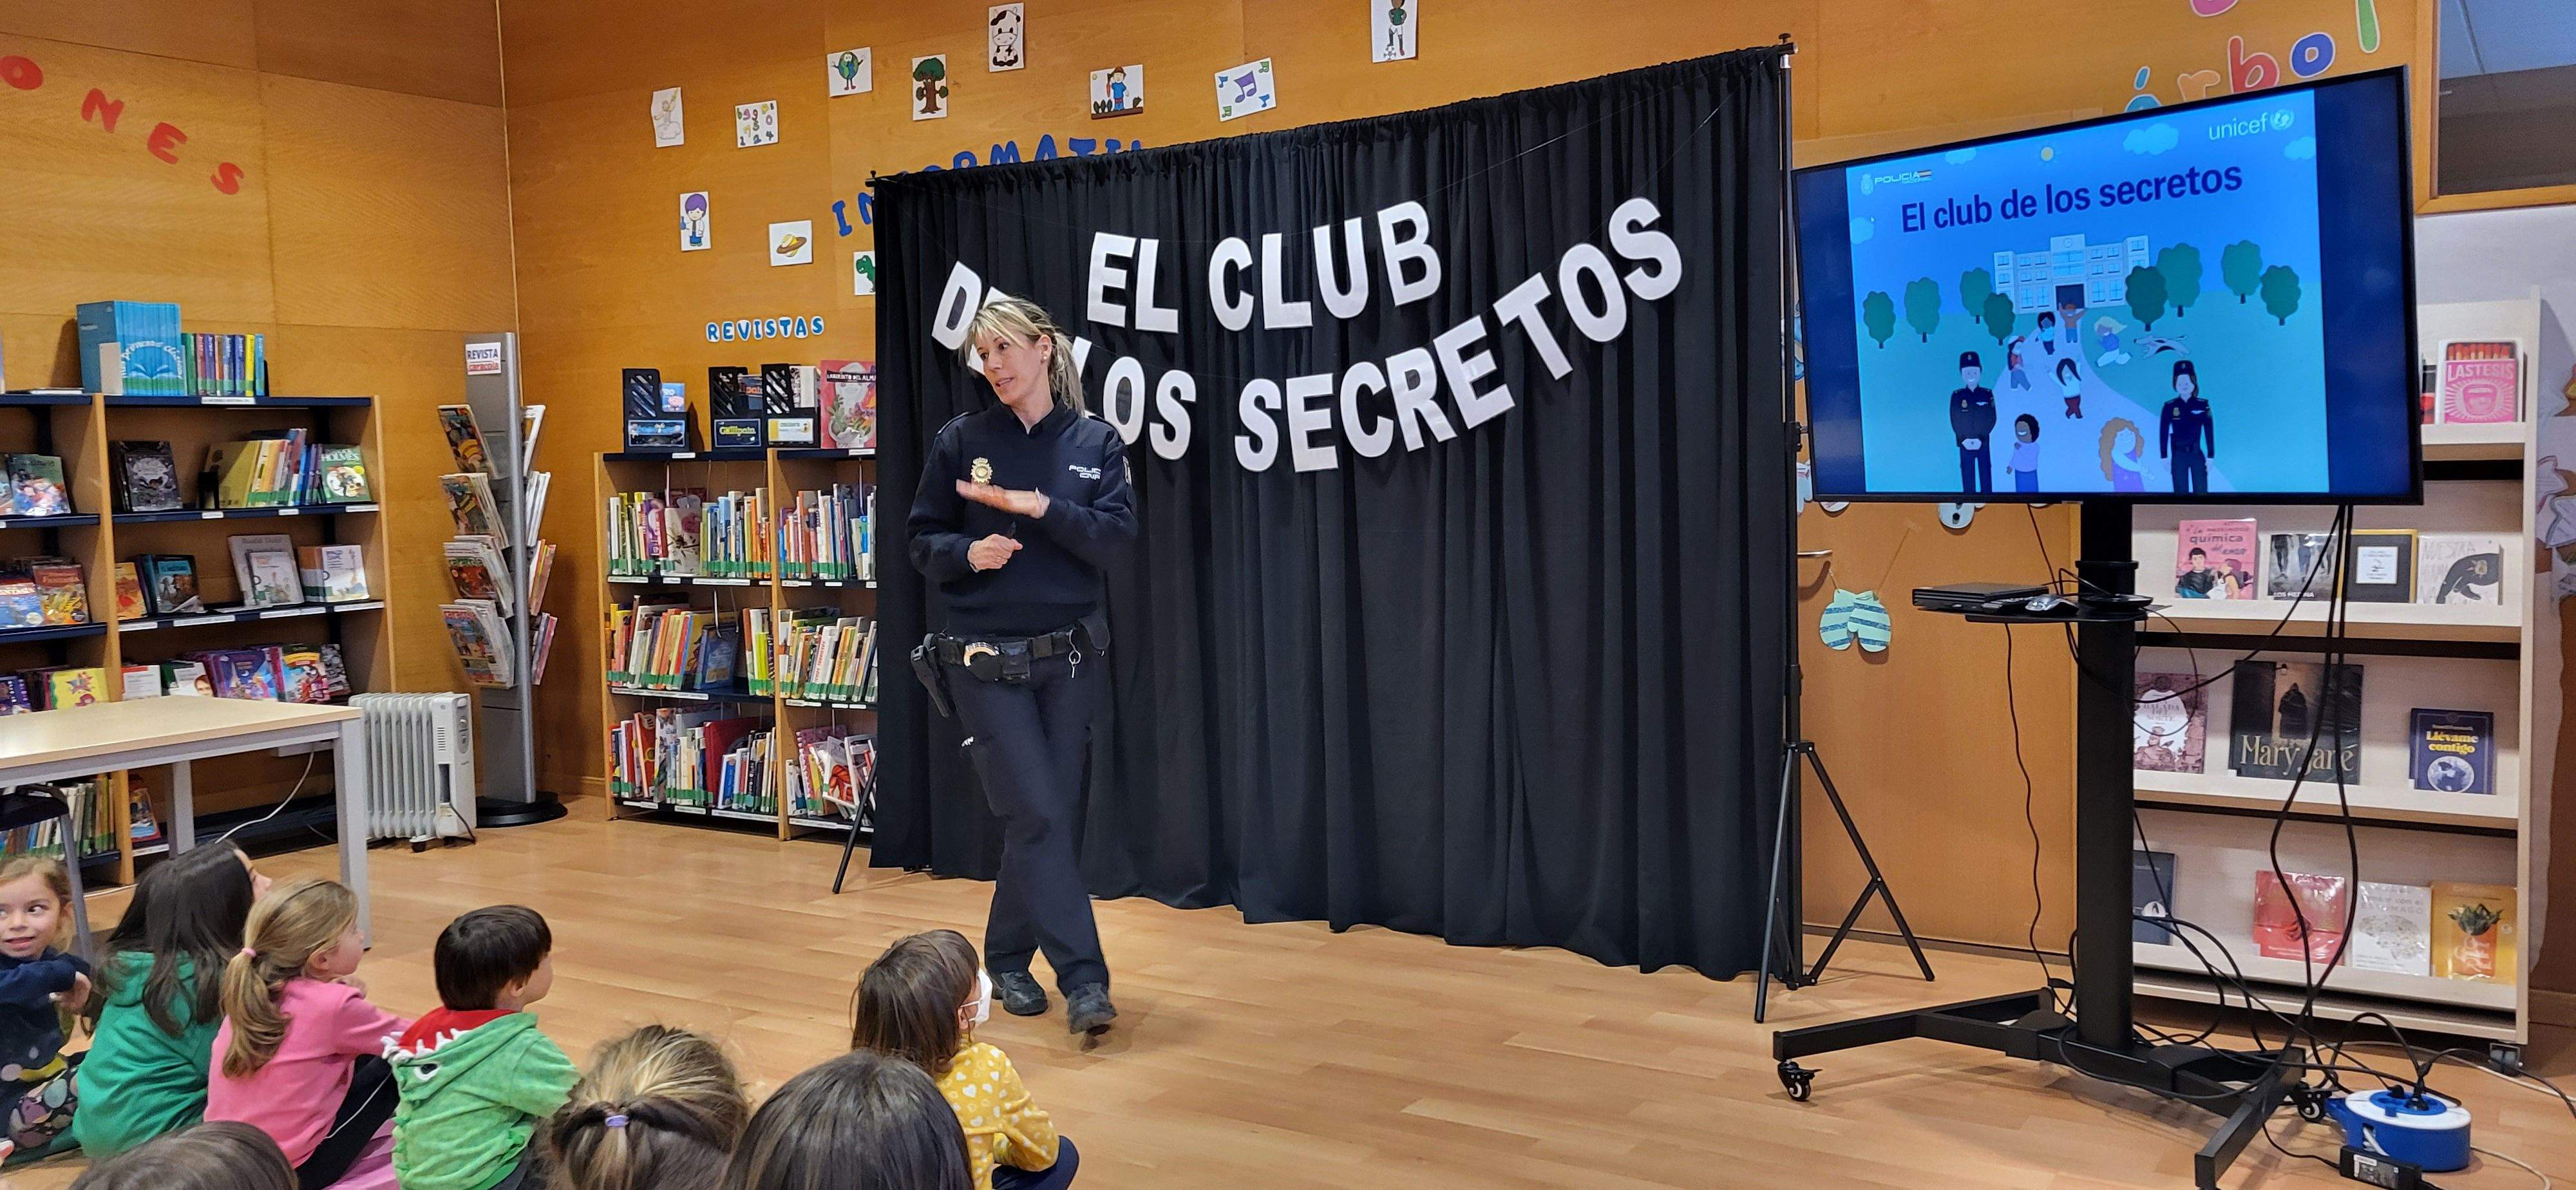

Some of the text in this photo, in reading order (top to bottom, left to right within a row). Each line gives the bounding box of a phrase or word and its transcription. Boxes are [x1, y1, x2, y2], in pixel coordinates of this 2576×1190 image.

[2208, 111, 2269, 141] unicef
[1901, 165, 2243, 233] El club de los secretos
[1086, 200, 1442, 334] EL CLUB
[706, 316, 824, 341] REVISTAS
[1234, 197, 1682, 473] SECRETOS
[467, 348, 498, 360] REVISTA
[2447, 363, 2515, 383] LASTESIS
[2240, 735, 2301, 776] Mary
[2428, 743, 2476, 755] contigo
